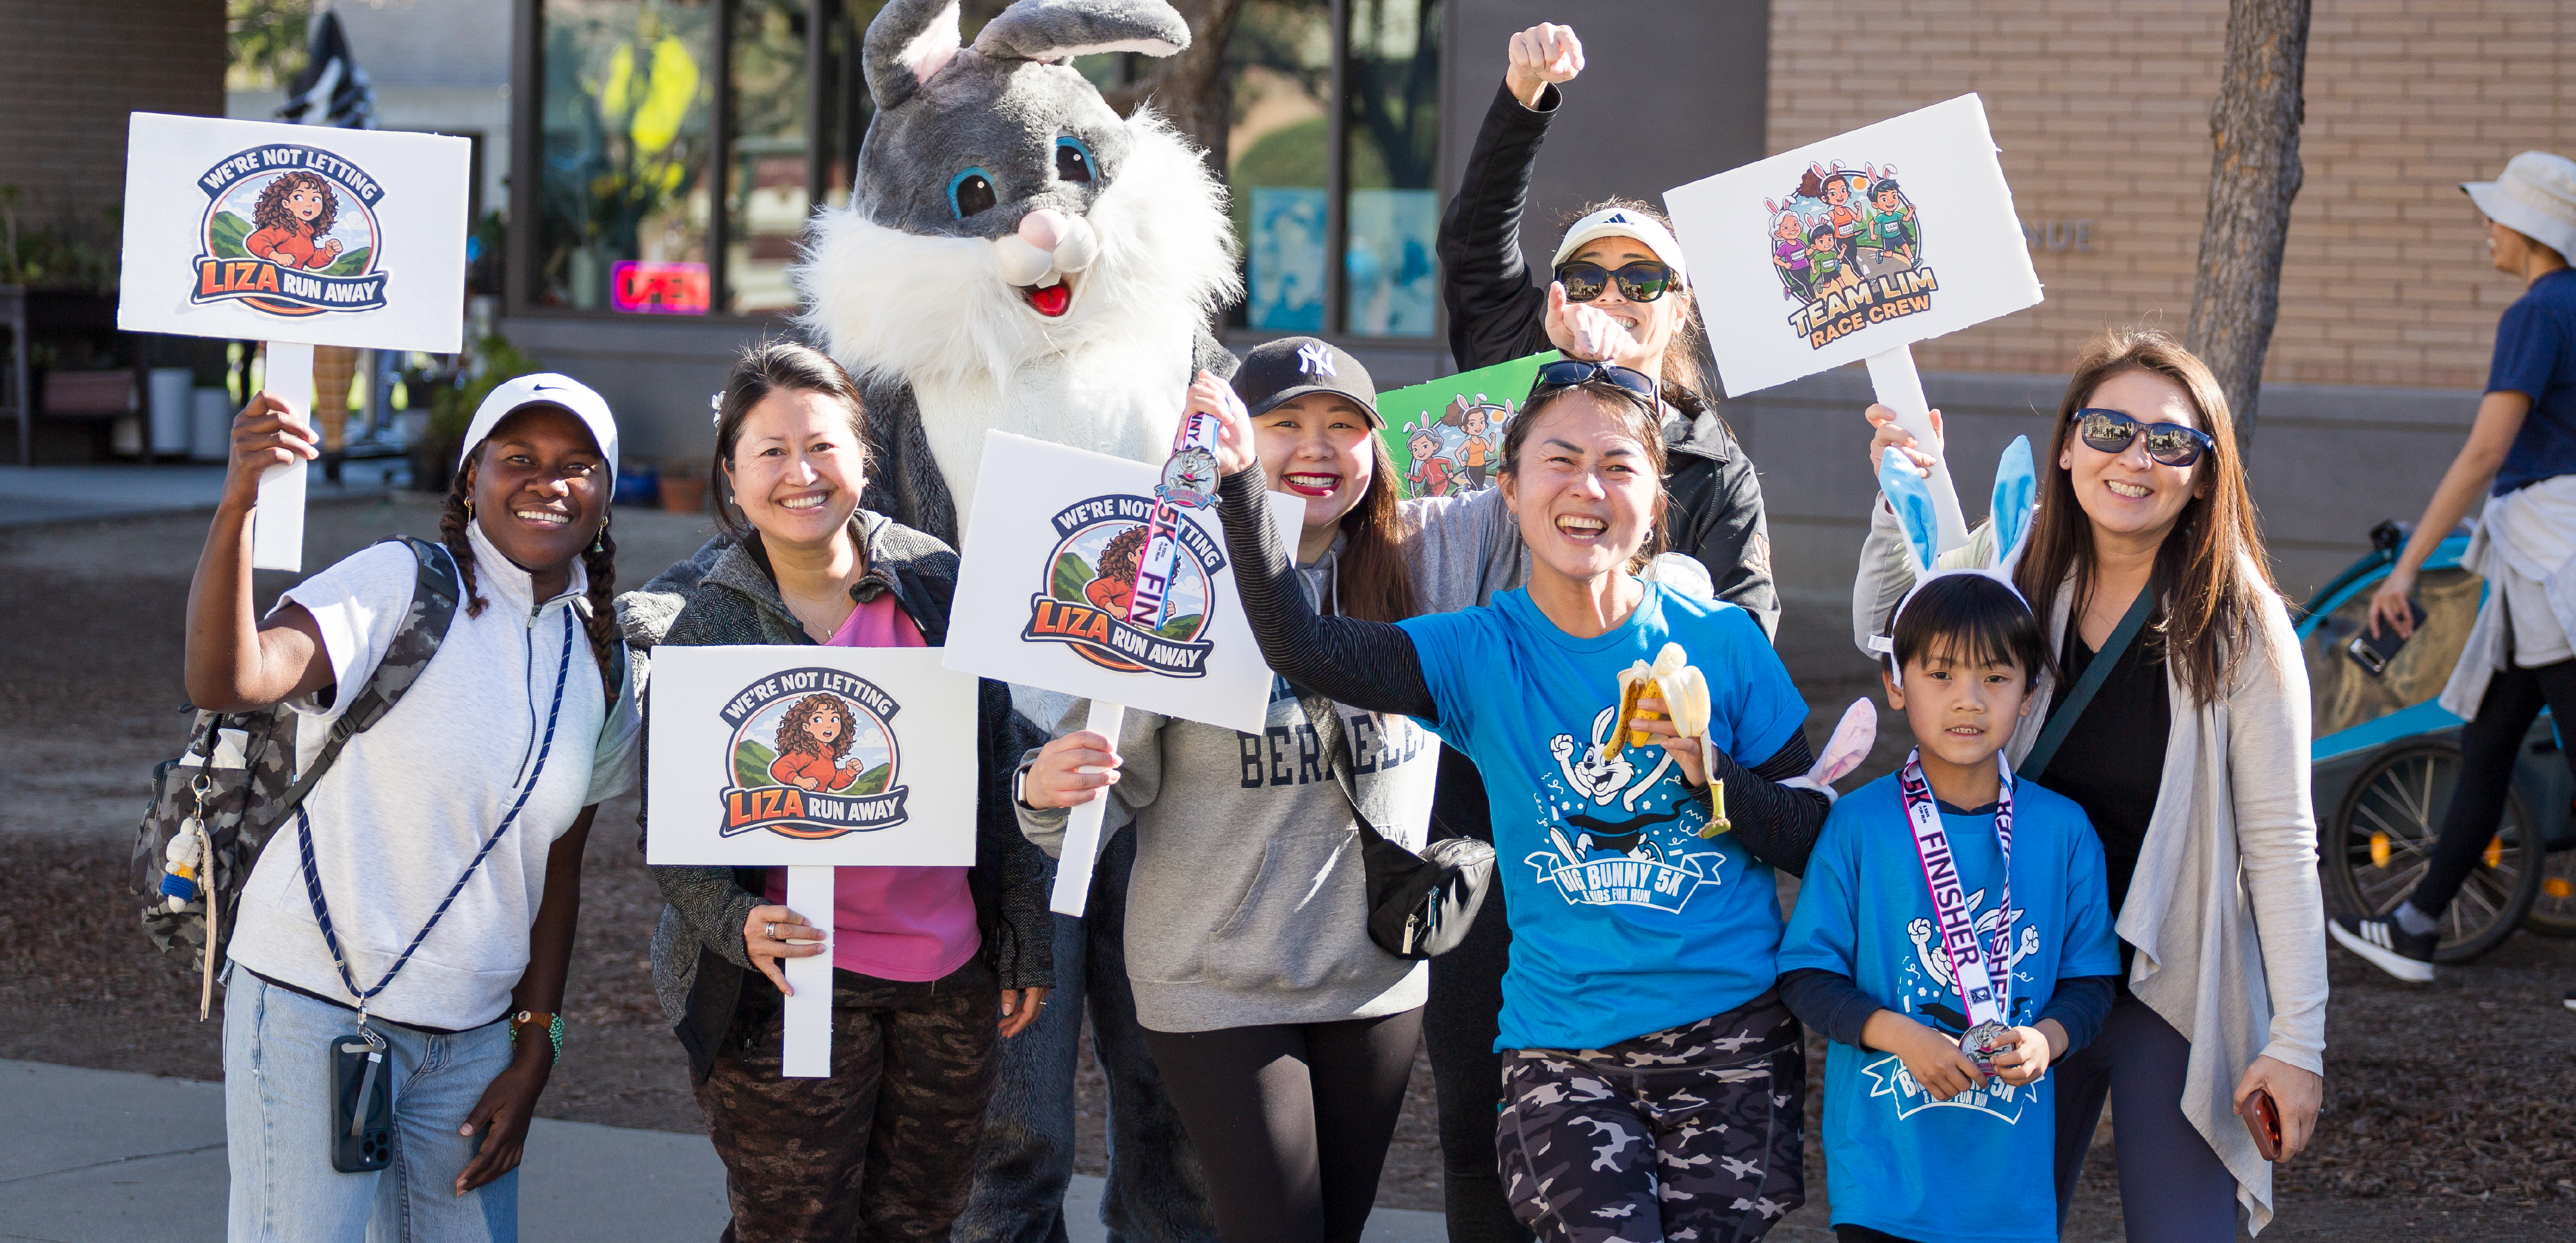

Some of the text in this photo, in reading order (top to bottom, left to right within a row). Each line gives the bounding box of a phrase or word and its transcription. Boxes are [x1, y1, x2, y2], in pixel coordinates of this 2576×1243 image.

[204, 149, 377, 200] WE'RE NOT LETTING
[202, 261, 379, 302] LIZA RUN AWAY
[616, 265, 710, 311] OPEN
[1790, 269, 1937, 336] TEAM LIM
[1811, 294, 1929, 348] RACE CREW
[1179, 489, 1196, 497] BUNNY
[1058, 499, 1220, 567] WE'RE NOT TTING
[1152, 502, 1179, 546] 5K
[1033, 601, 1203, 668] LIZA RUN AWAY
[726, 672, 893, 719] WE'RE NOT LETTING
[1236, 713, 1426, 788] BERELE
[729, 789, 899, 827] LIZA RUN AWAY
[1904, 777, 1933, 809] 5K
[1558, 863, 1686, 896] BIG BUNNY 5K
[1582, 888, 1651, 903] & KIDS FUN RUN
[1918, 830, 1979, 968] FINISHER
[1989, 882, 2009, 1014] INISHE
[1964, 987, 1973, 1009] CUPERTINO
[1923, 1091, 1930, 1104] &
[1974, 1092, 1988, 1107] RUN
